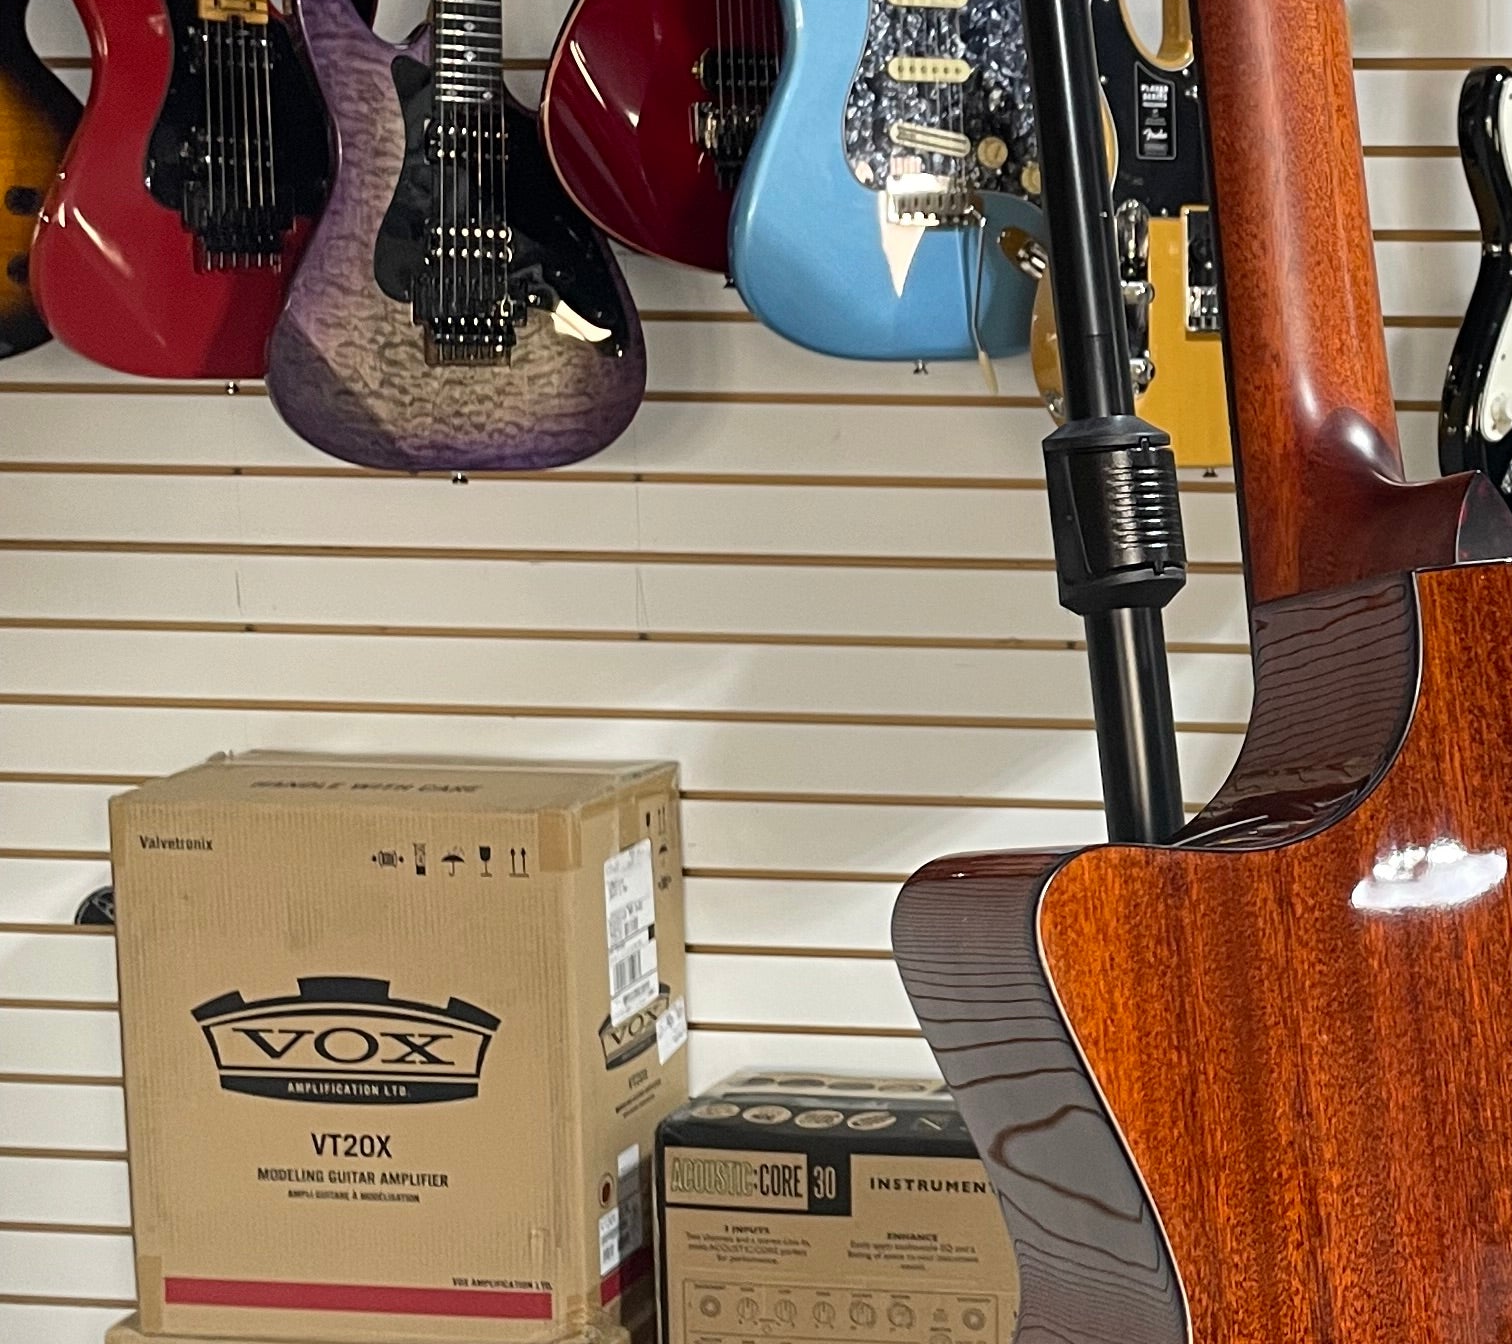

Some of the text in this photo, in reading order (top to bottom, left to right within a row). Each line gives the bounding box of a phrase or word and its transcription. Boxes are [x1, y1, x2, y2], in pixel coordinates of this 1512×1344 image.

[139, 834, 213, 851] Valvetronix
[232, 1027, 455, 1066] VOX
[287, 1082, 379, 1097] AMPLIFICATION
[311, 1133, 393, 1159] VT20X
[257, 1168, 449, 1188] MODELING GUITAR AMPLIFIER
[813, 1165, 836, 1200] 30
[869, 1176, 991, 1194] INSTRUMEN
